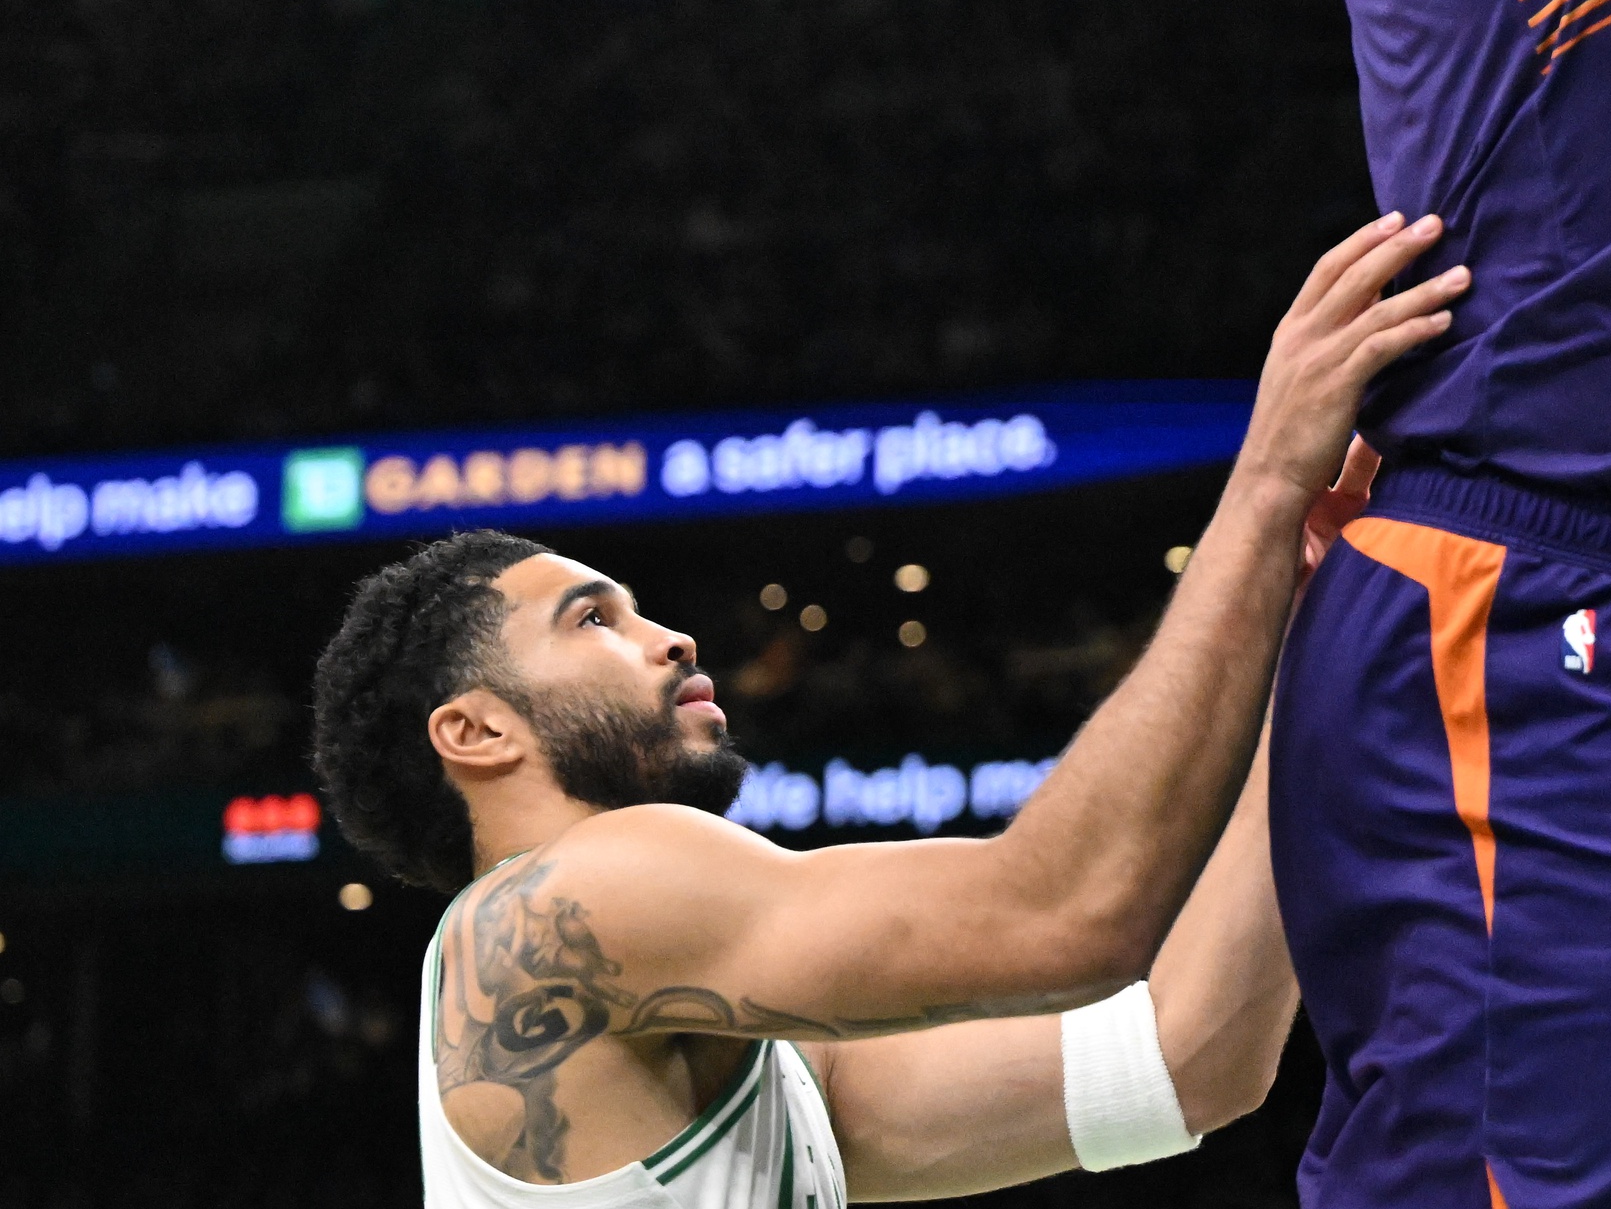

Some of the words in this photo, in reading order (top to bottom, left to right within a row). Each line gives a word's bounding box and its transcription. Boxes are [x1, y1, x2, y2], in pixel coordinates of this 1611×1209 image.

[0, 471, 89, 552] elp
[91, 459, 259, 537] make
[365, 441, 647, 515] GARDEN
